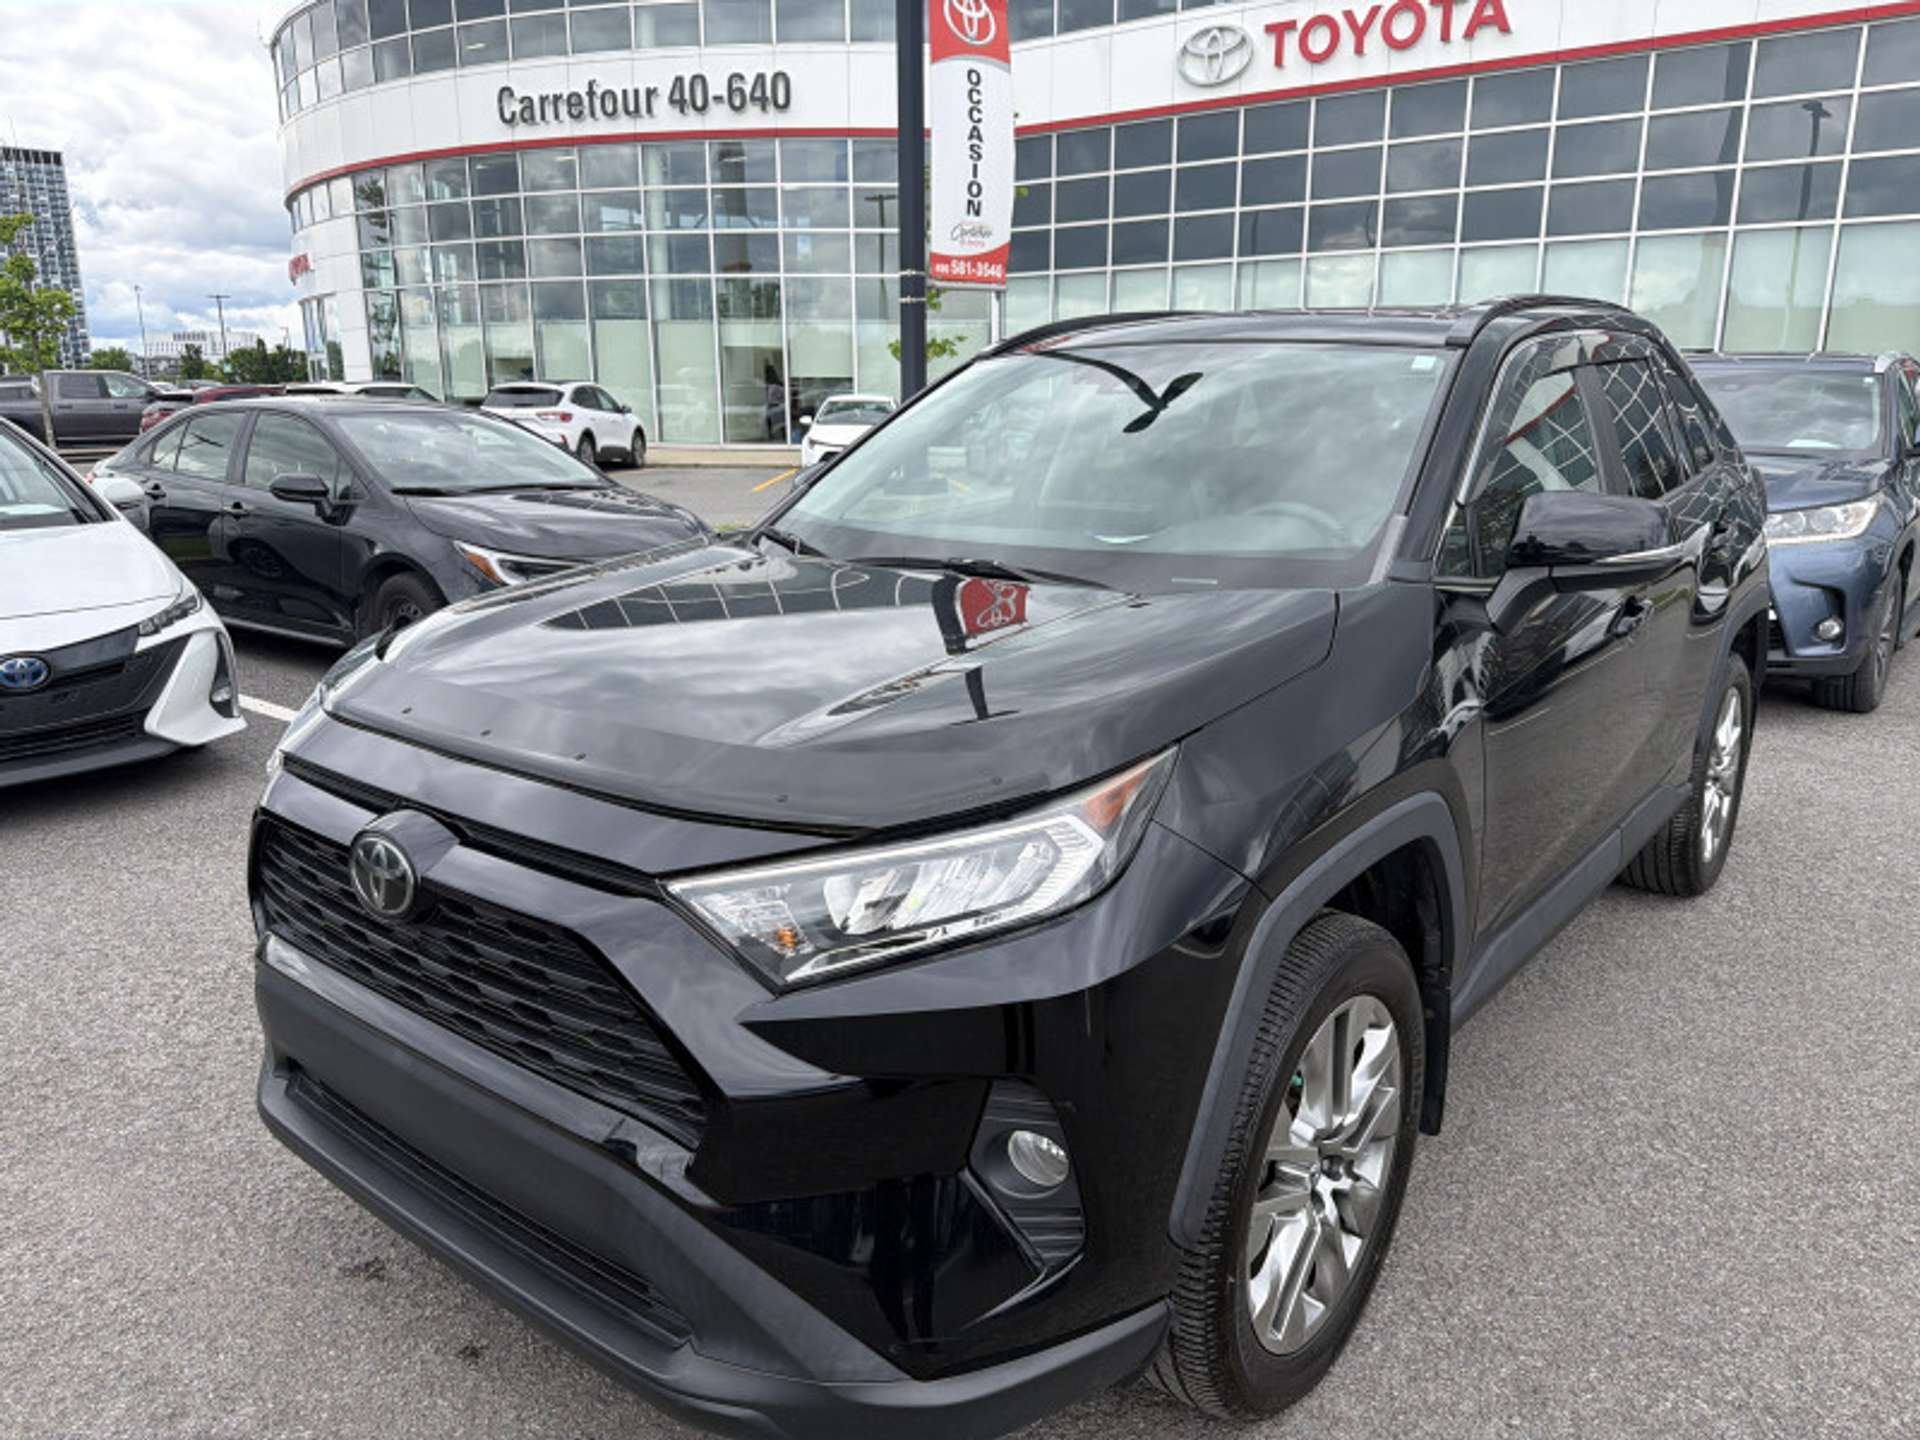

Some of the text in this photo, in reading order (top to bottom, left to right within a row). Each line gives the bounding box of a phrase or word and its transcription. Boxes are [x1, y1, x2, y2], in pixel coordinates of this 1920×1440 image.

[1264, 0, 1511, 67] TOYOTA
[497, 71, 791, 125] Carrefour 40-640
[966, 68, 984, 217] OCCASION
